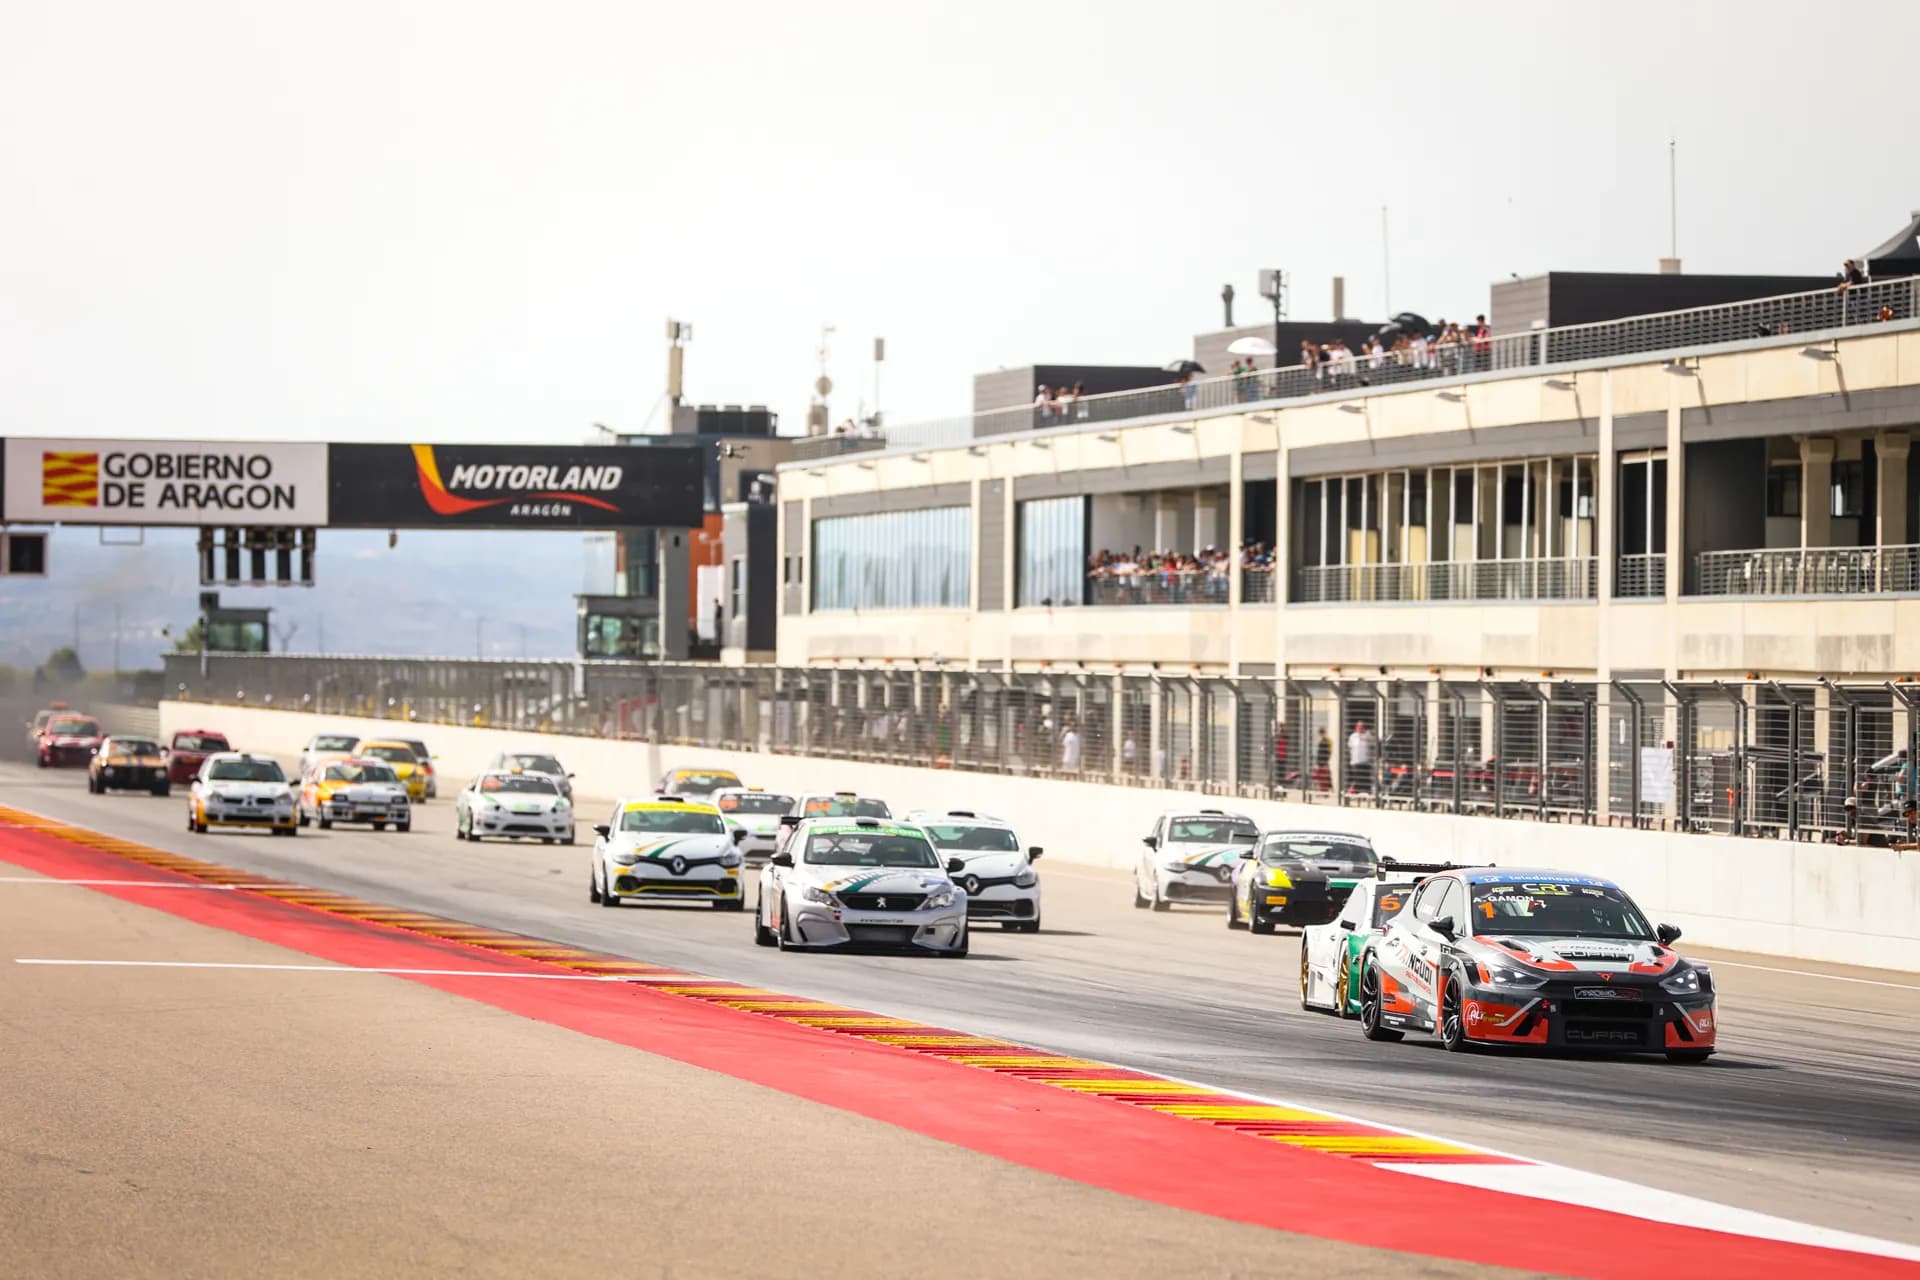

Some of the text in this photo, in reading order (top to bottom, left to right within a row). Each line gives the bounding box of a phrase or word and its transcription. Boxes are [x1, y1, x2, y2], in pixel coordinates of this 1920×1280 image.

[103, 452, 273, 480] GOBIERNO
[450, 464, 623, 490] MOTORLAND
[103, 482, 296, 510] DE ARAGON
[510, 502, 572, 517] ARAGÓN
[1521, 883, 1571, 893] CRT
[1380, 896, 1402, 911] 5
[1478, 901, 1496, 919] 1
[1566, 1029, 1638, 1041] CUPRA
